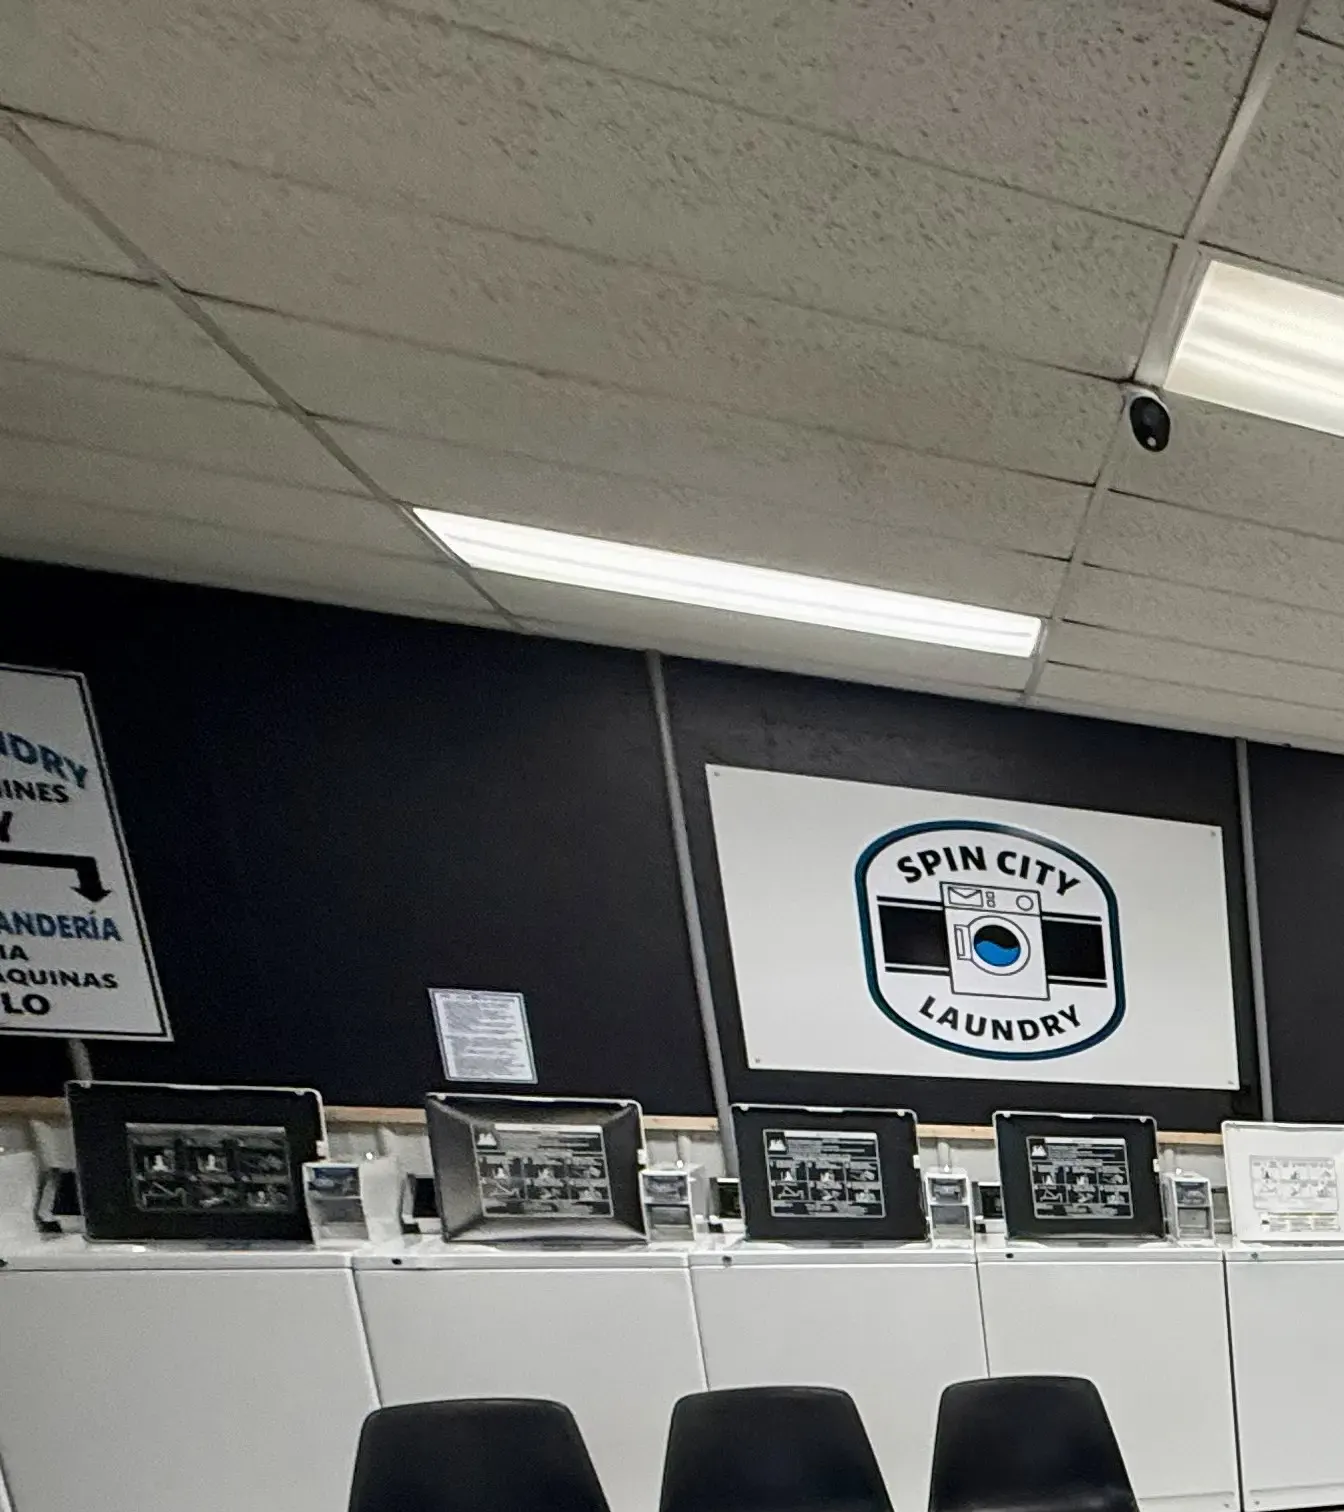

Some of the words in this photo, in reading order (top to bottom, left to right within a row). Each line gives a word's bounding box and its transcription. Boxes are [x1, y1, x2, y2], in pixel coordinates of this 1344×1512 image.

[0, 780, 69, 803] INES
[897, 846, 987, 883] SPIN
[997, 850, 1081, 896] CITY
[919, 996, 1081, 1041] LAUNDRY
